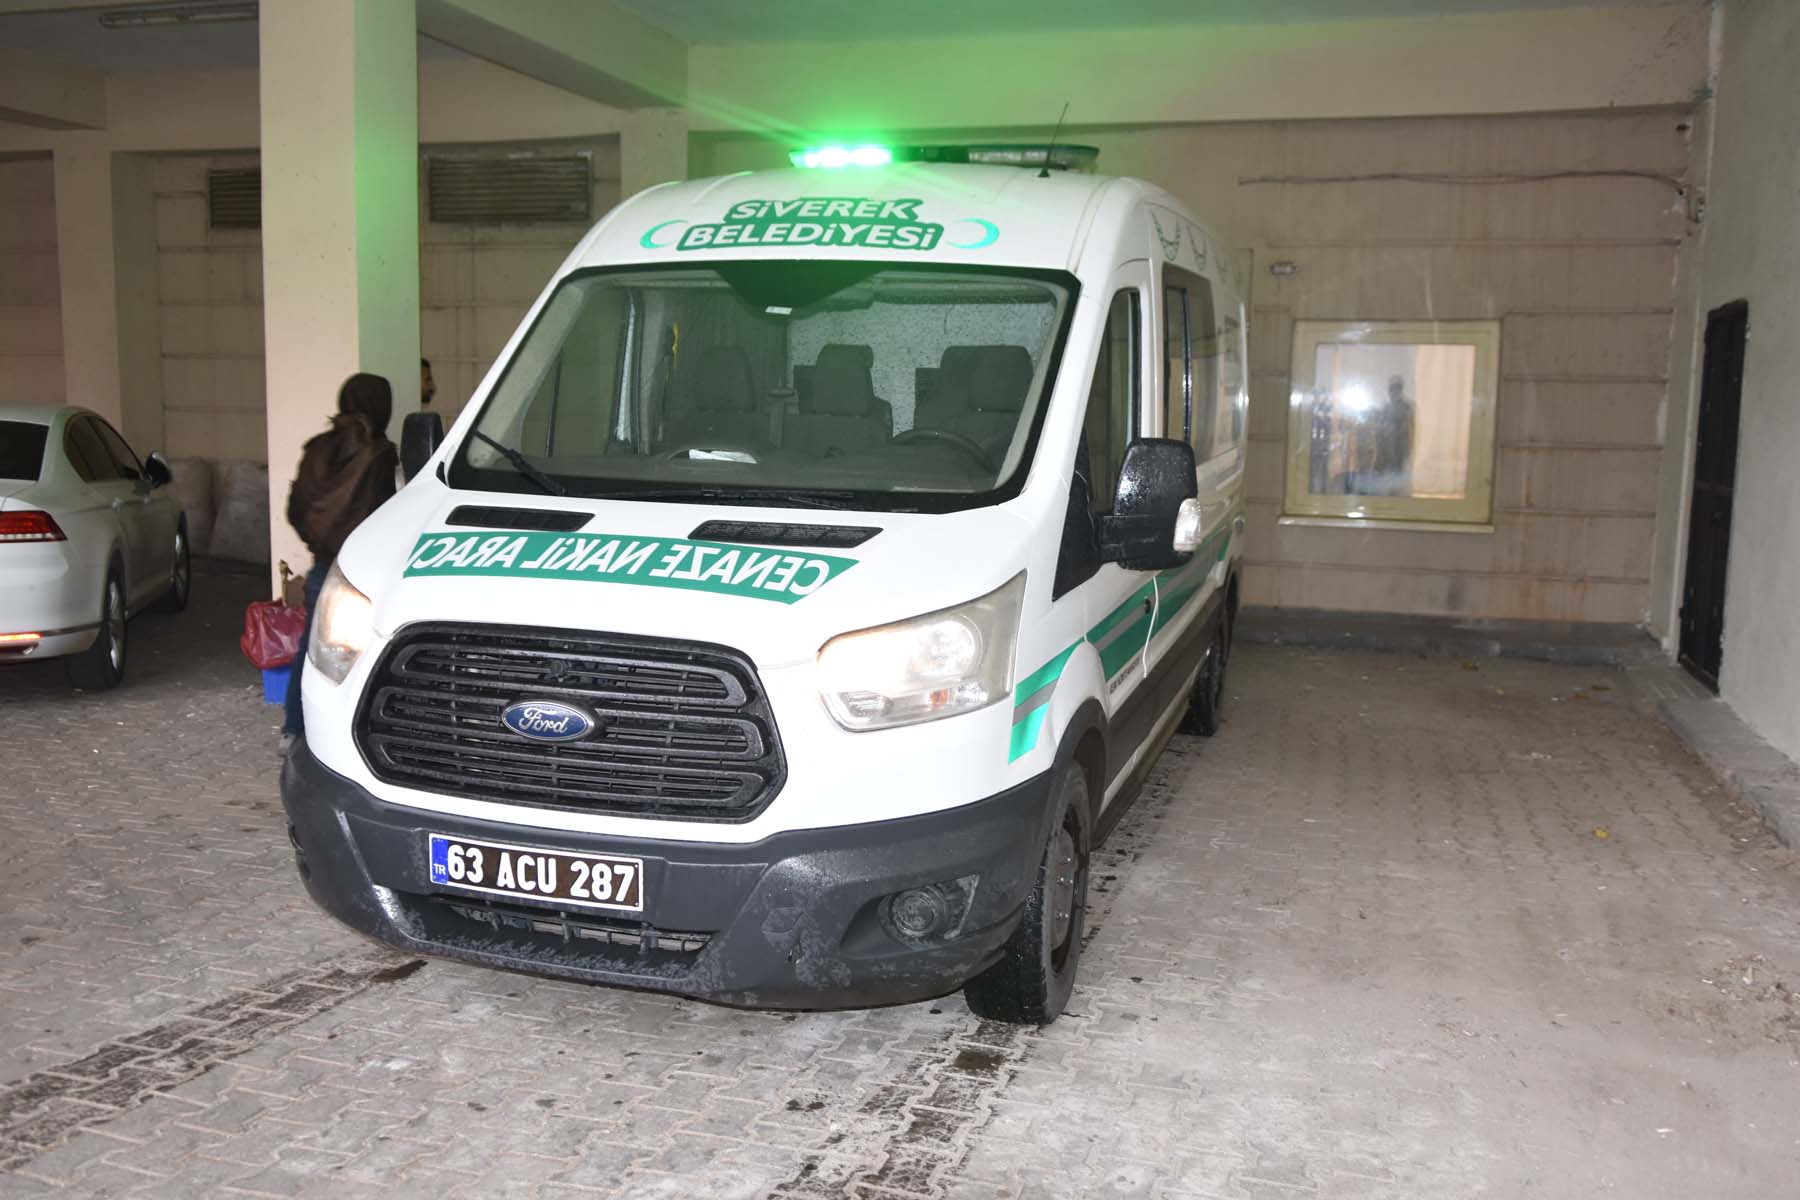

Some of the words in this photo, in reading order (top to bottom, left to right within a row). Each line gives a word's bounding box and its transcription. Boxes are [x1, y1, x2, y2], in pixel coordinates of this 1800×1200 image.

[518, 706, 569, 734] Ford
[433, 863, 447, 875] TR
[447, 845, 484, 884] 63
[496, 852, 557, 894] ACU
[570, 860, 635, 902] 287
